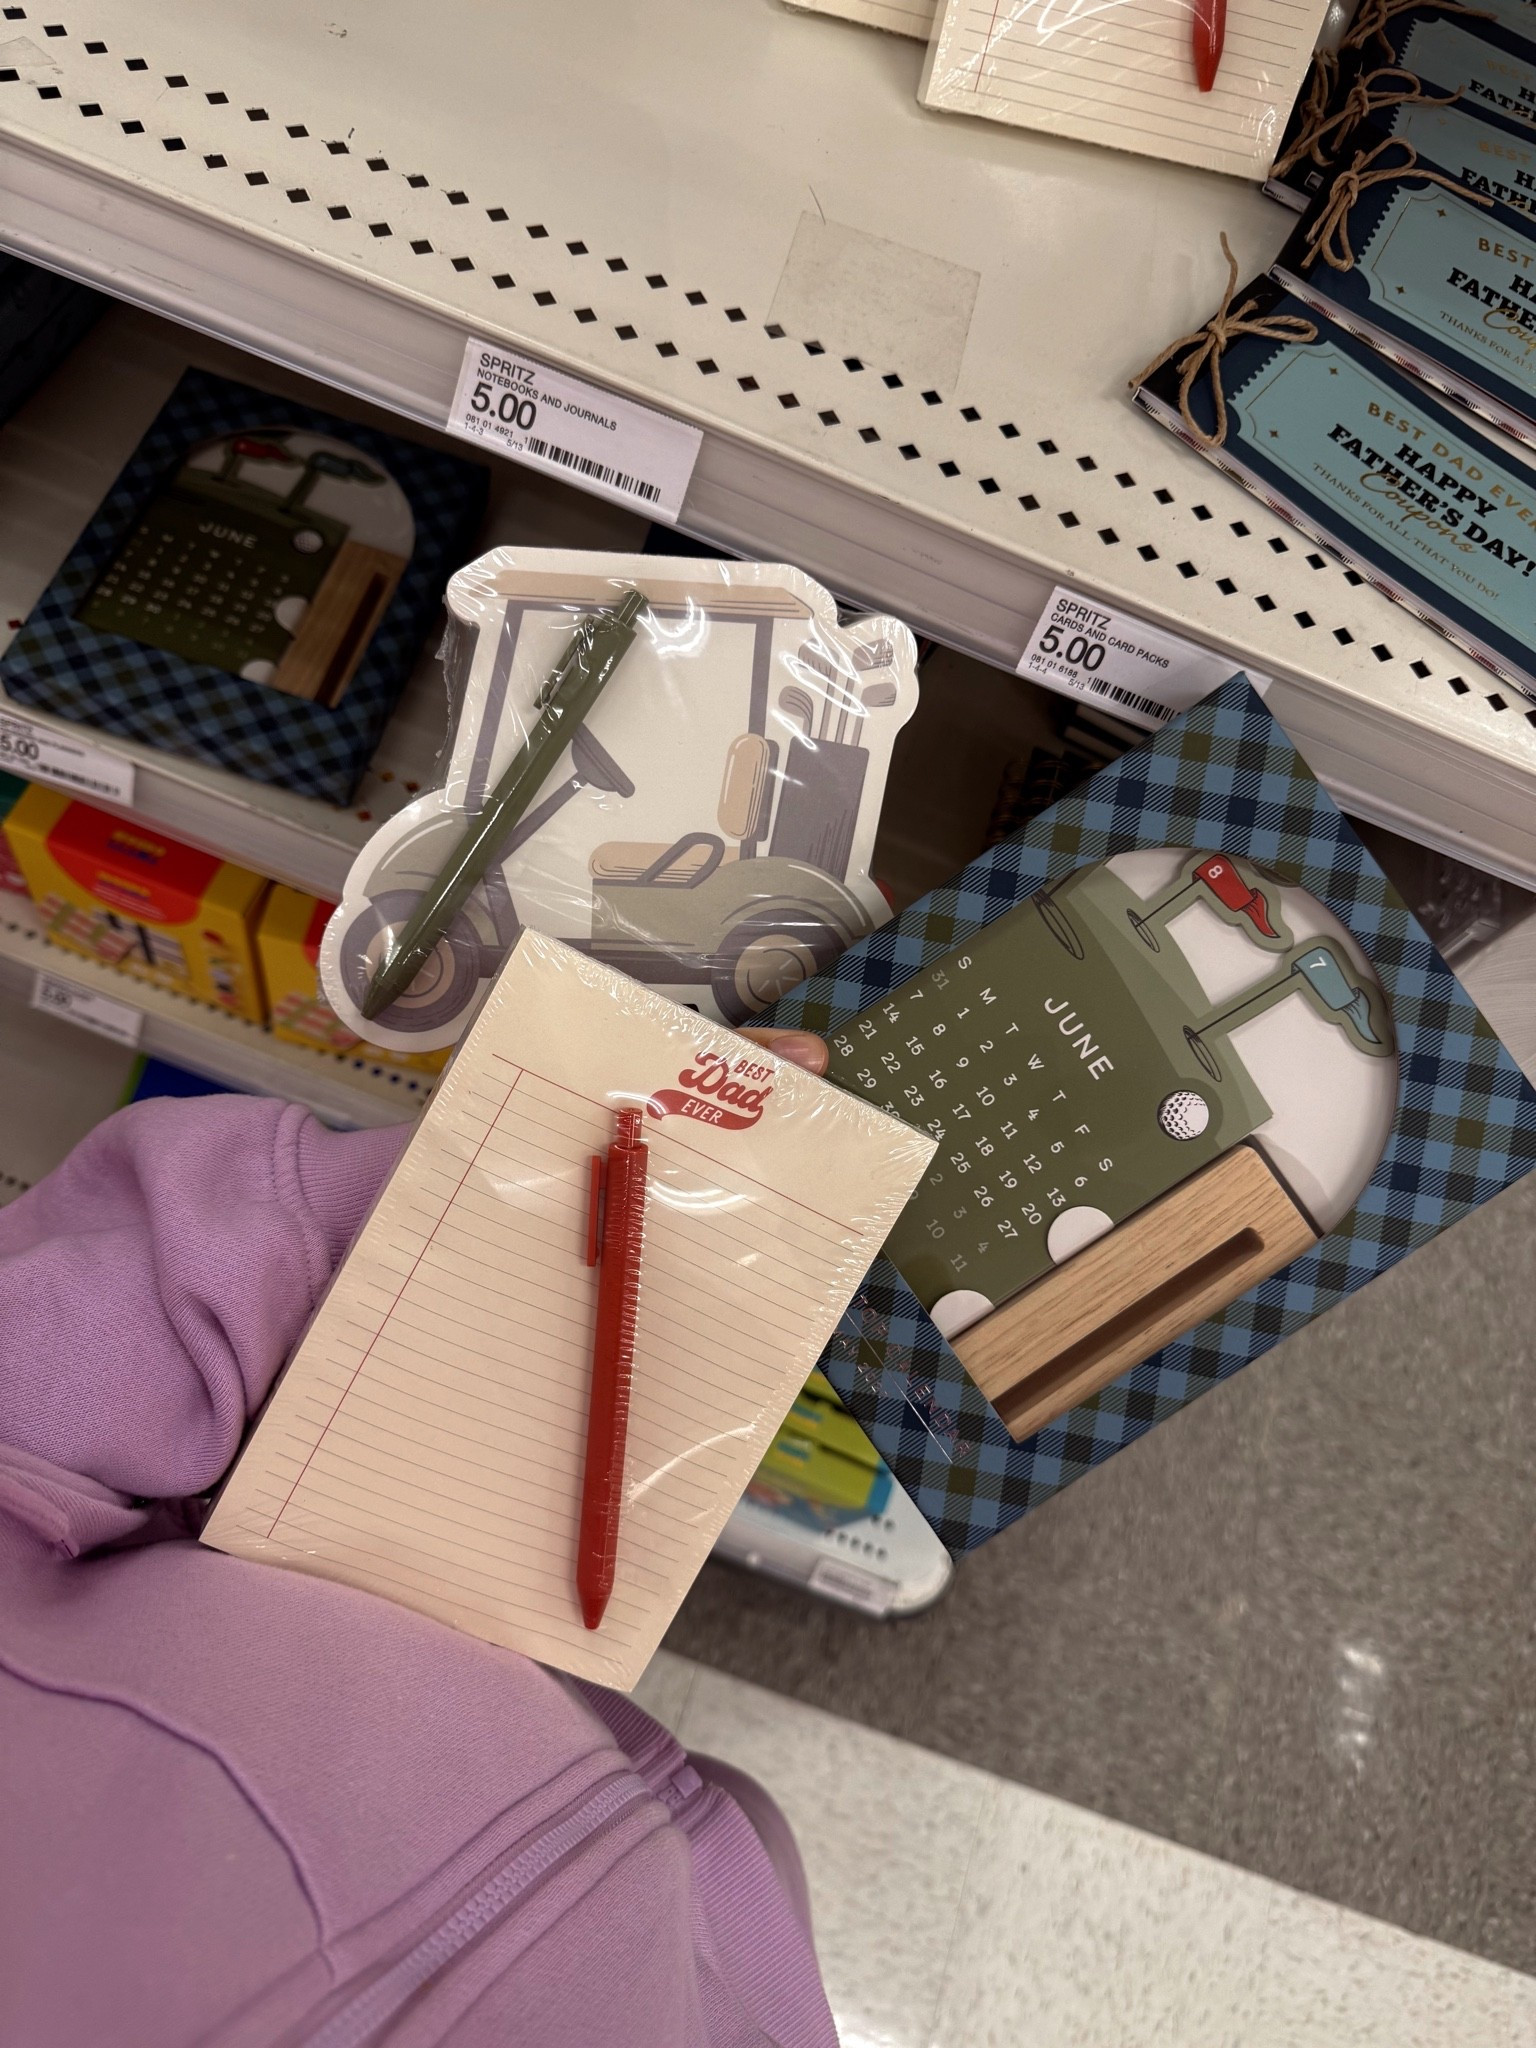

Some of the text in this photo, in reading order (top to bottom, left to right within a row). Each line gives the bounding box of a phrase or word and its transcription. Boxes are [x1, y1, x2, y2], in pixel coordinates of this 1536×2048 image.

[1478, 237, 1534, 269] BEST
[1446, 267, 1536, 333] FATHE
[1440, 310, 1487, 342] THANKS
[1488, 339, 1511, 359] FOR
[480, 353, 536, 385] SPRITZ
[465, 413, 514, 438] 081 01 4921
[471, 382, 537, 431] 5.00
[477, 367, 617, 431] NOTEBOOKS AND JOURNALS
[464, 422, 484, 436] 1-4-3
[506, 438, 523, 452] 5/13
[1368, 401, 1426, 441] BEST
[1432, 442, 1483, 481] DAD
[1327, 423, 1536, 577] FATHER'S DAY!
[1394, 443, 1498, 519] HAPPY
[199, 522, 258, 550] JUNE
[1313, 462, 1500, 600] THANKS FOR ALL THAT YOU DO!
[1360, 471, 1477, 554] Coupons
[1050, 612, 1170, 669] CARDS AND CARD PACKS
[1056, 599, 1111, 630] SPRITZ
[1031, 653, 1079, 679] 081 01 6188
[1039, 625, 1106, 672] 5.00
[1068, 677, 1085, 691] 5/13
[1208, 865, 1223, 879] 8
[1309, 957, 1326, 969] 7
[958, 956, 1113, 1172] S M T W T F S
[1044, 998, 1114, 1081] JUNE
[678, 1051, 774, 1112] Dad
[734, 1059, 775, 1083] BEST
[931, 970, 1088, 1188] 31 1 2 3 4 5 6
[681, 1099, 723, 1124] EVER
[882, 1003, 1042, 1225] 14 15 16 17 18 19 20
[909, 989, 1066, 1207] 7 8 9 10 11 12 13
[834, 1035, 854, 1057] 28
[857, 1068, 877, 1089] 29
[930, 1173, 943, 1186] 2
[953, 1206, 967, 1219] 3
[977, 1241, 990, 1254] 4
[859, 1020, 1018, 1240] 21 22 23 24 25 26 27
[926, 1219, 968, 1272] 10 11
